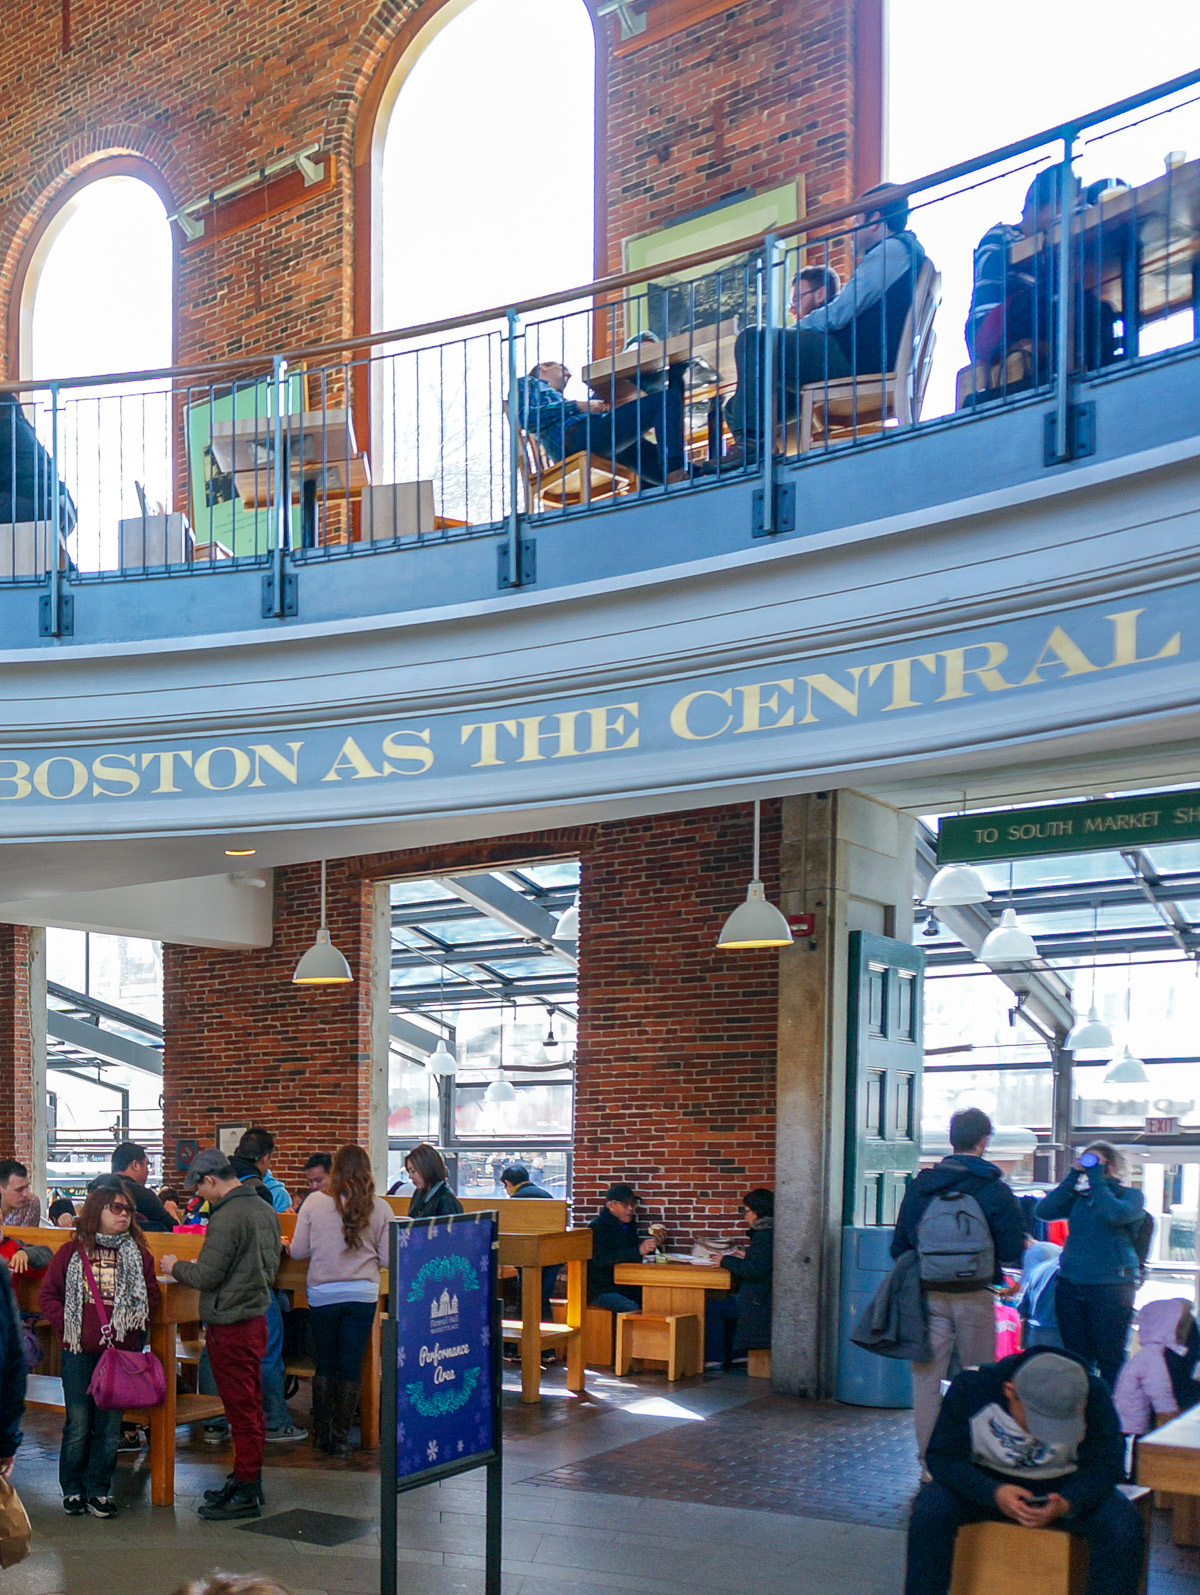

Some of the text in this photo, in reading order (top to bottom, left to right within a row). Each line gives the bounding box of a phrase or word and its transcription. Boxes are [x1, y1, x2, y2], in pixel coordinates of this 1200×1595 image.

[319, 727, 436, 781] AS
[460, 701, 641, 767] THE
[669, 608, 1182, 740] CENTRAL
[974, 828, 999, 844] TO
[1008, 820, 1074, 840] SOUTH
[1084, 811, 1162, 833] MARKET
[1149, 1118, 1174, 1133] EXIT
[419, 1342, 470, 1367] Performance
[434, 1365, 456, 1384] Area
